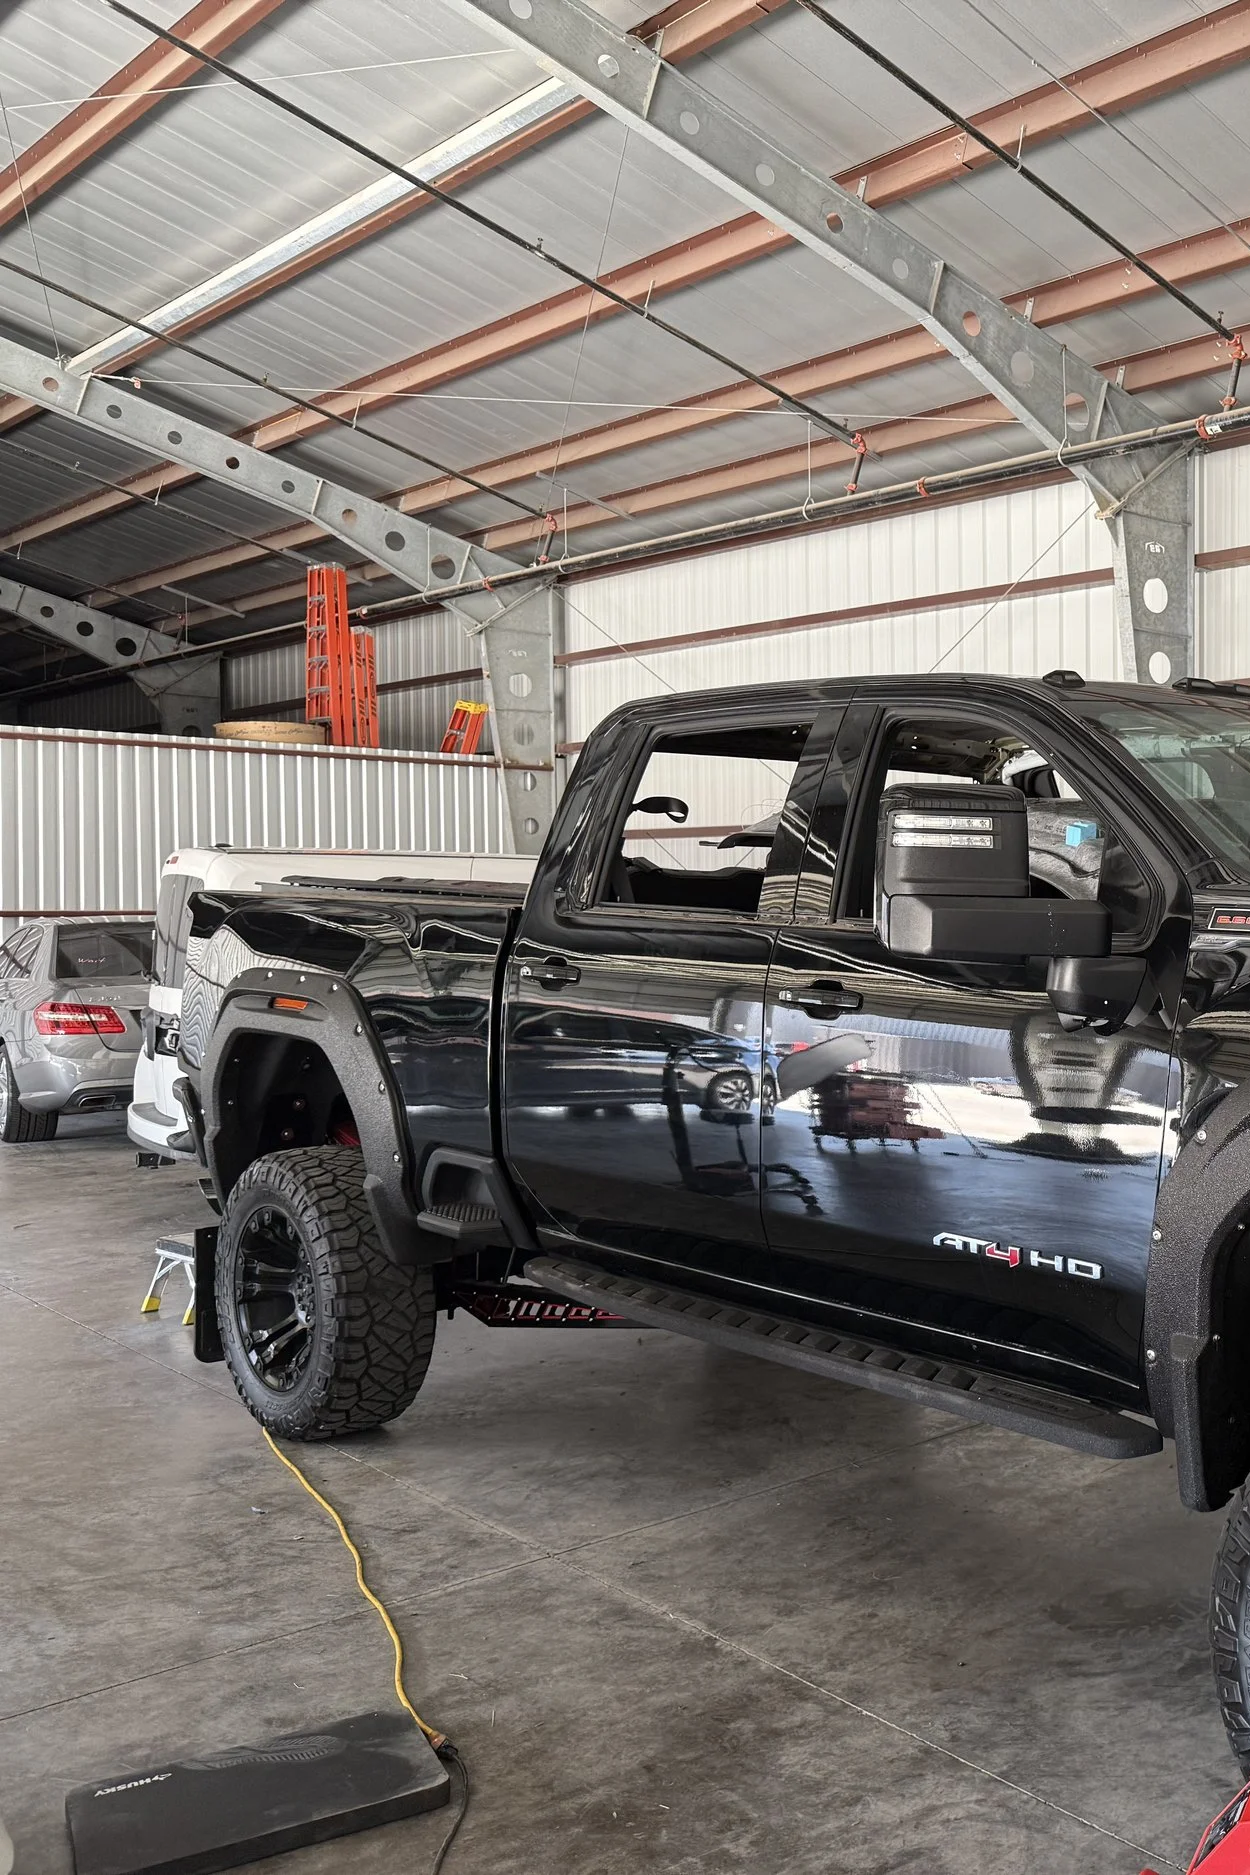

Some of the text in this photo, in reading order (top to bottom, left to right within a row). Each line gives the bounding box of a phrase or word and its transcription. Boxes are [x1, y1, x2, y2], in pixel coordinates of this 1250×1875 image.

[932, 1231, 1102, 1280] AT4 HD
[93, 1777, 152, 1797] HUSKY
